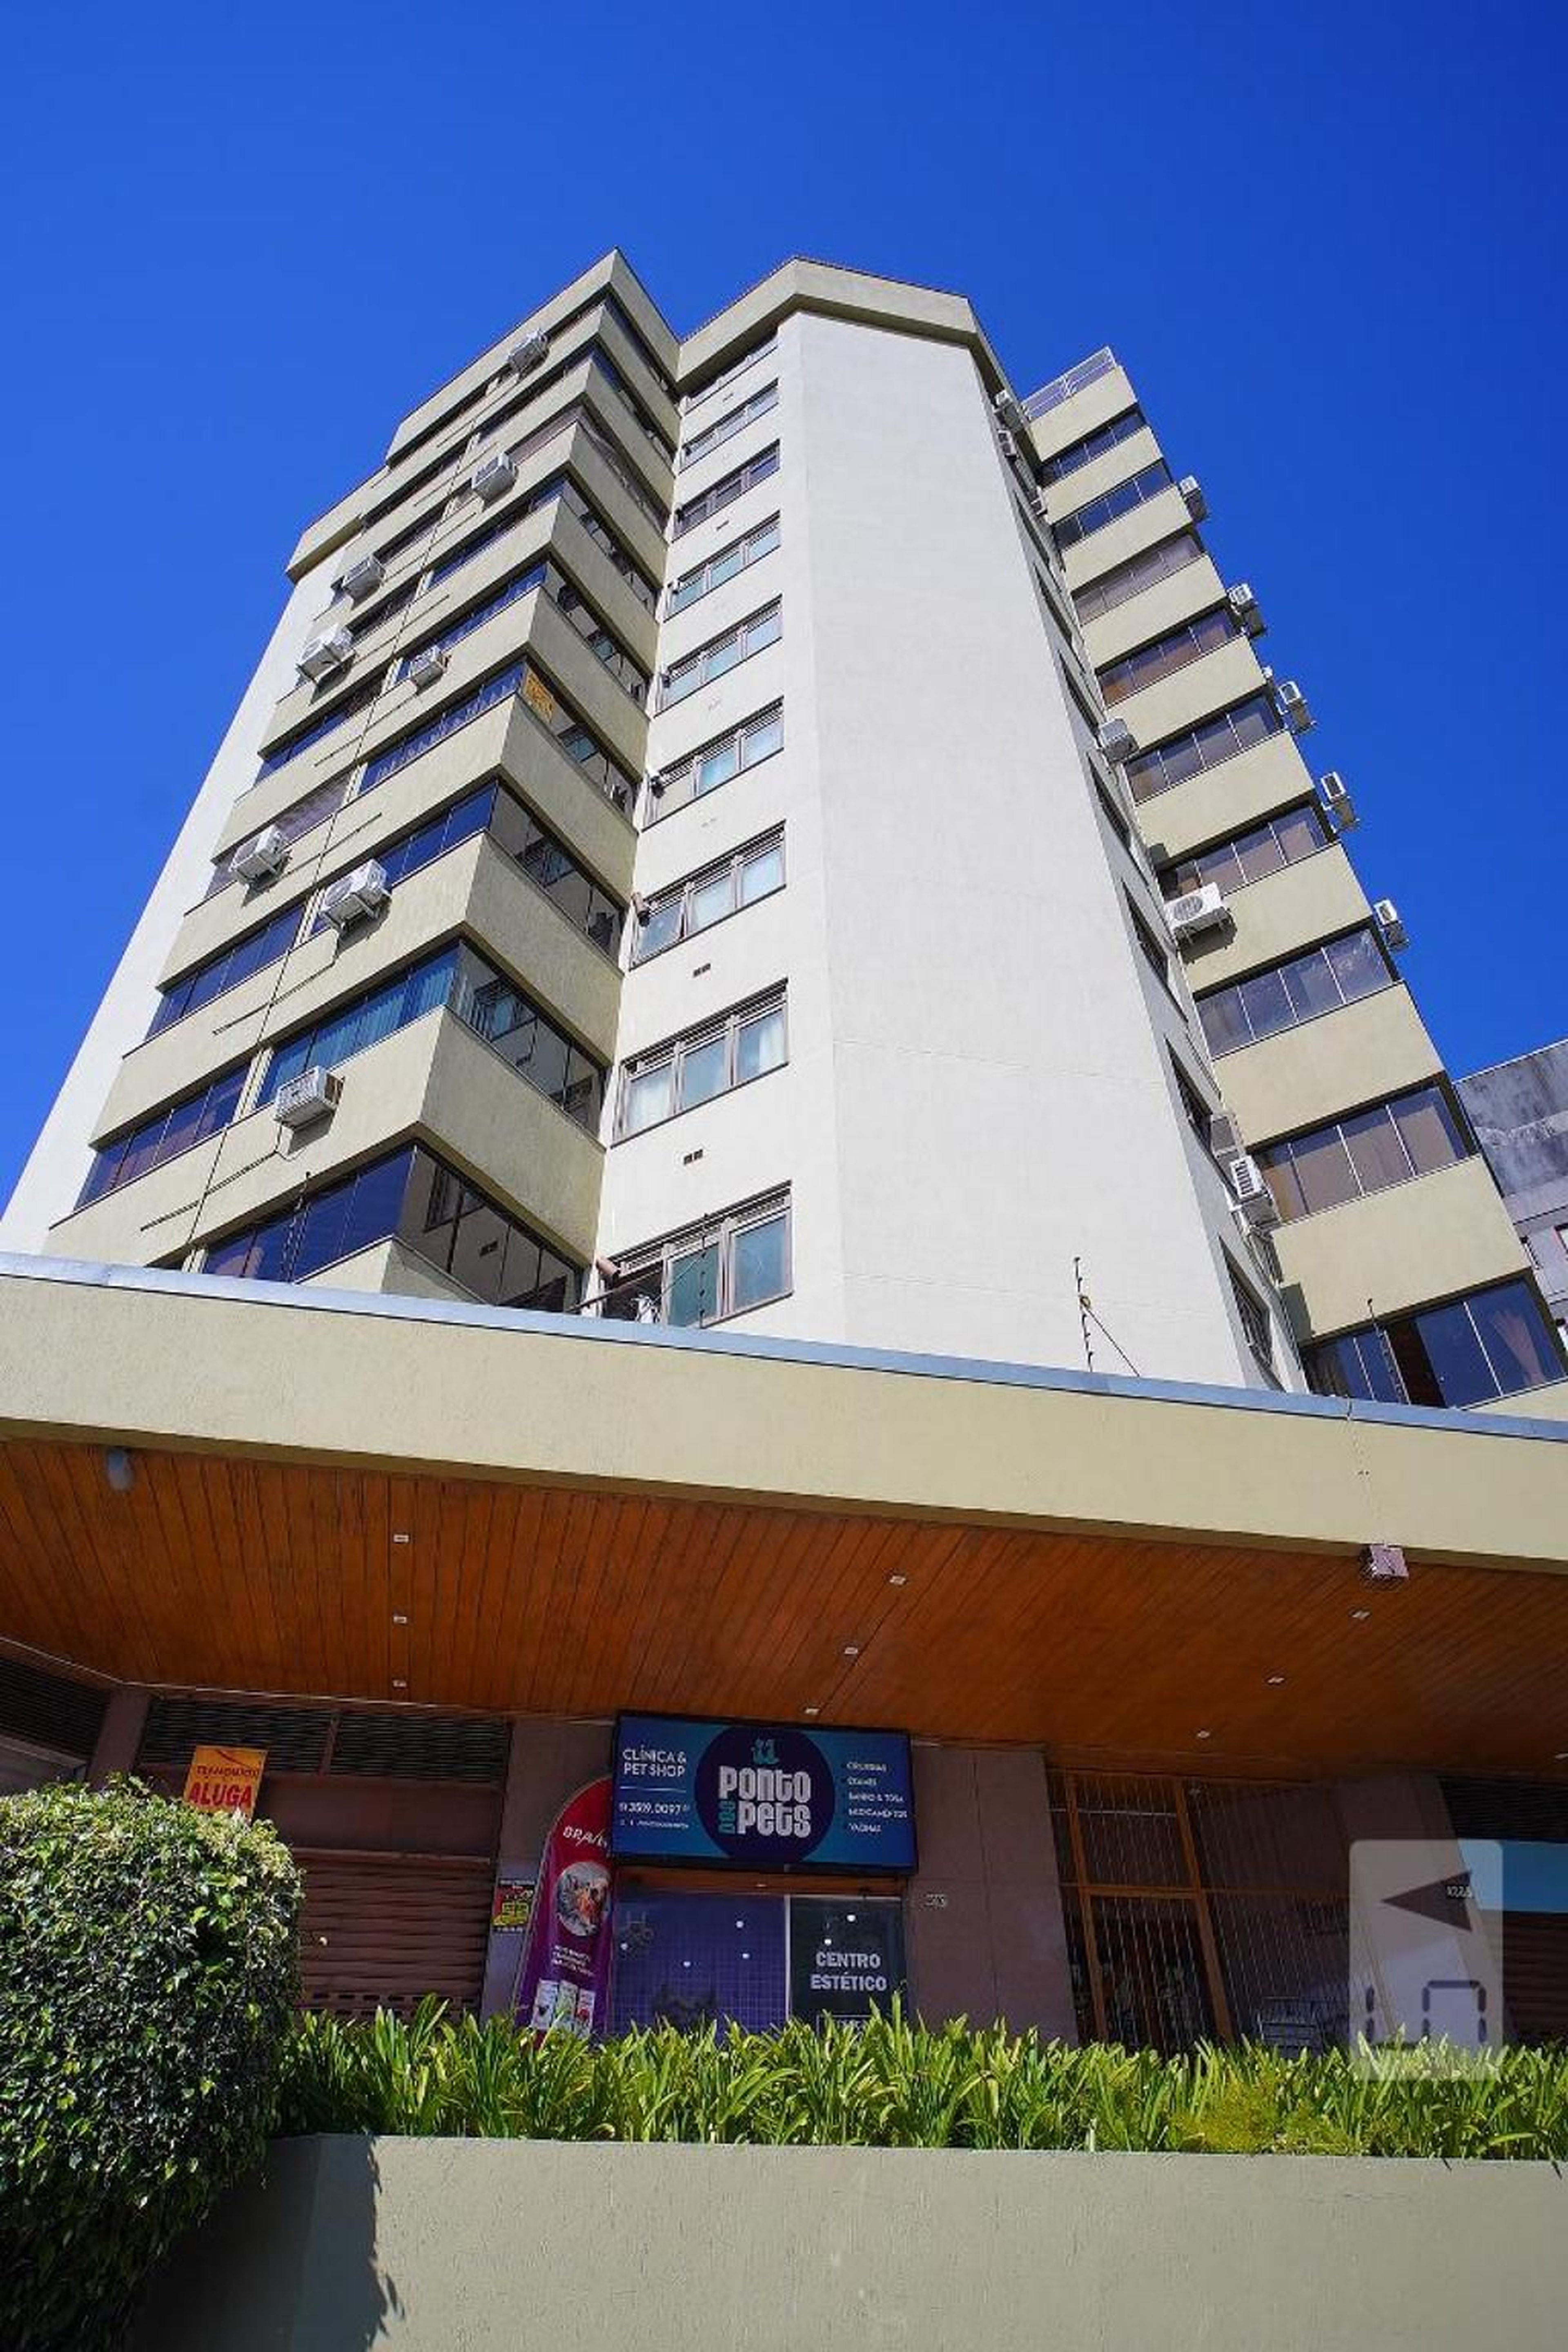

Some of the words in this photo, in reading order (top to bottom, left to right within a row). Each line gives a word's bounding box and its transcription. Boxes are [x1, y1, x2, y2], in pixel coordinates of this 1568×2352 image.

[622, 1744, 674, 1763] CLÍNICA
[677, 1751, 686, 1764] &
[624, 1762, 647, 1775] PET
[648, 1764, 685, 1777] SHOP
[189, 1781, 252, 1808] ALUGA
[816, 1951, 881, 1969] CENTRO
[811, 1971, 887, 1991] ESTÉTICO
